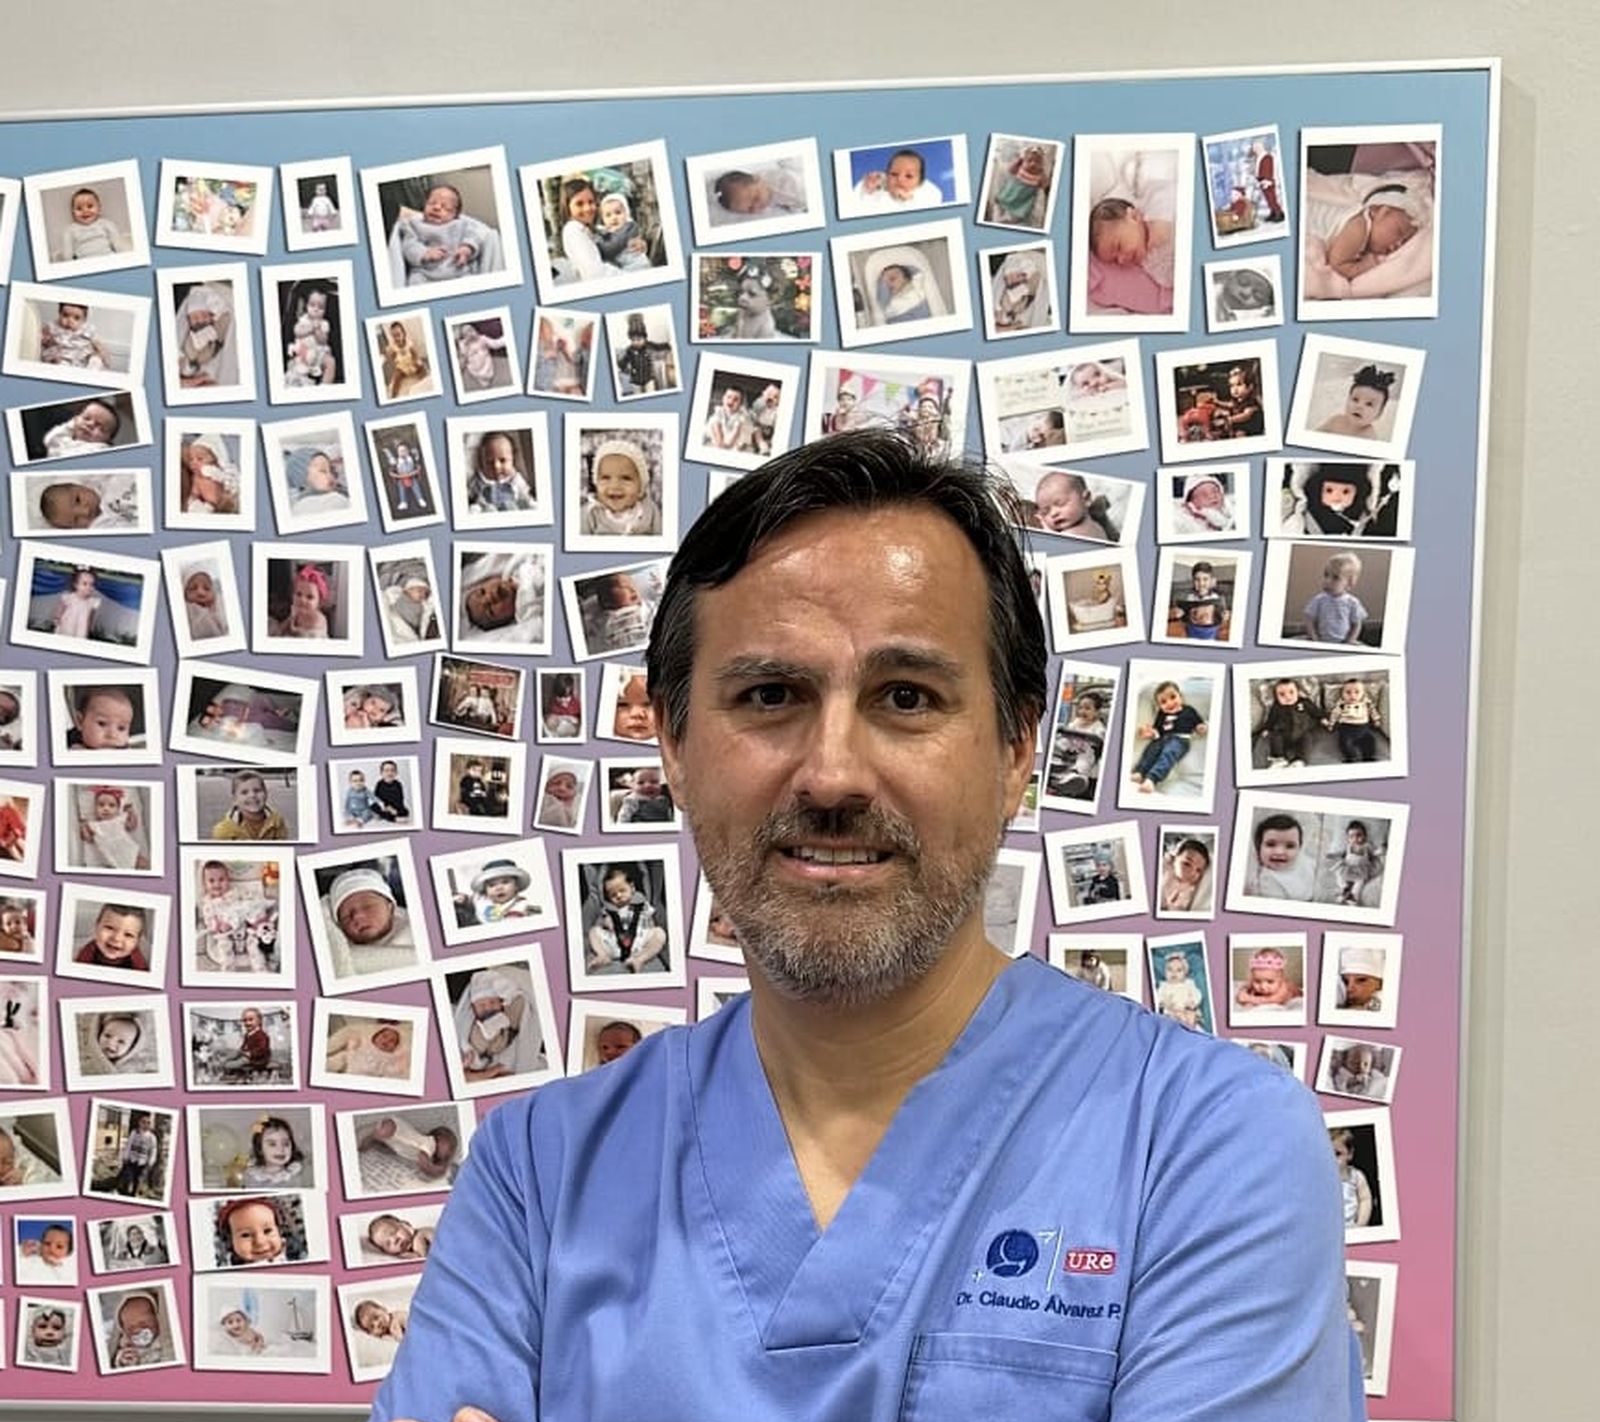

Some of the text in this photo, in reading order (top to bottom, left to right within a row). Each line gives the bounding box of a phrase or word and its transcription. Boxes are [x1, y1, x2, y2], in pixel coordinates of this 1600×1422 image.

[979, 1290, 1040, 1310] Claudio
[1044, 1294, 1104, 1318] Álvarez
[1107, 1303, 1122, 1320] P.
